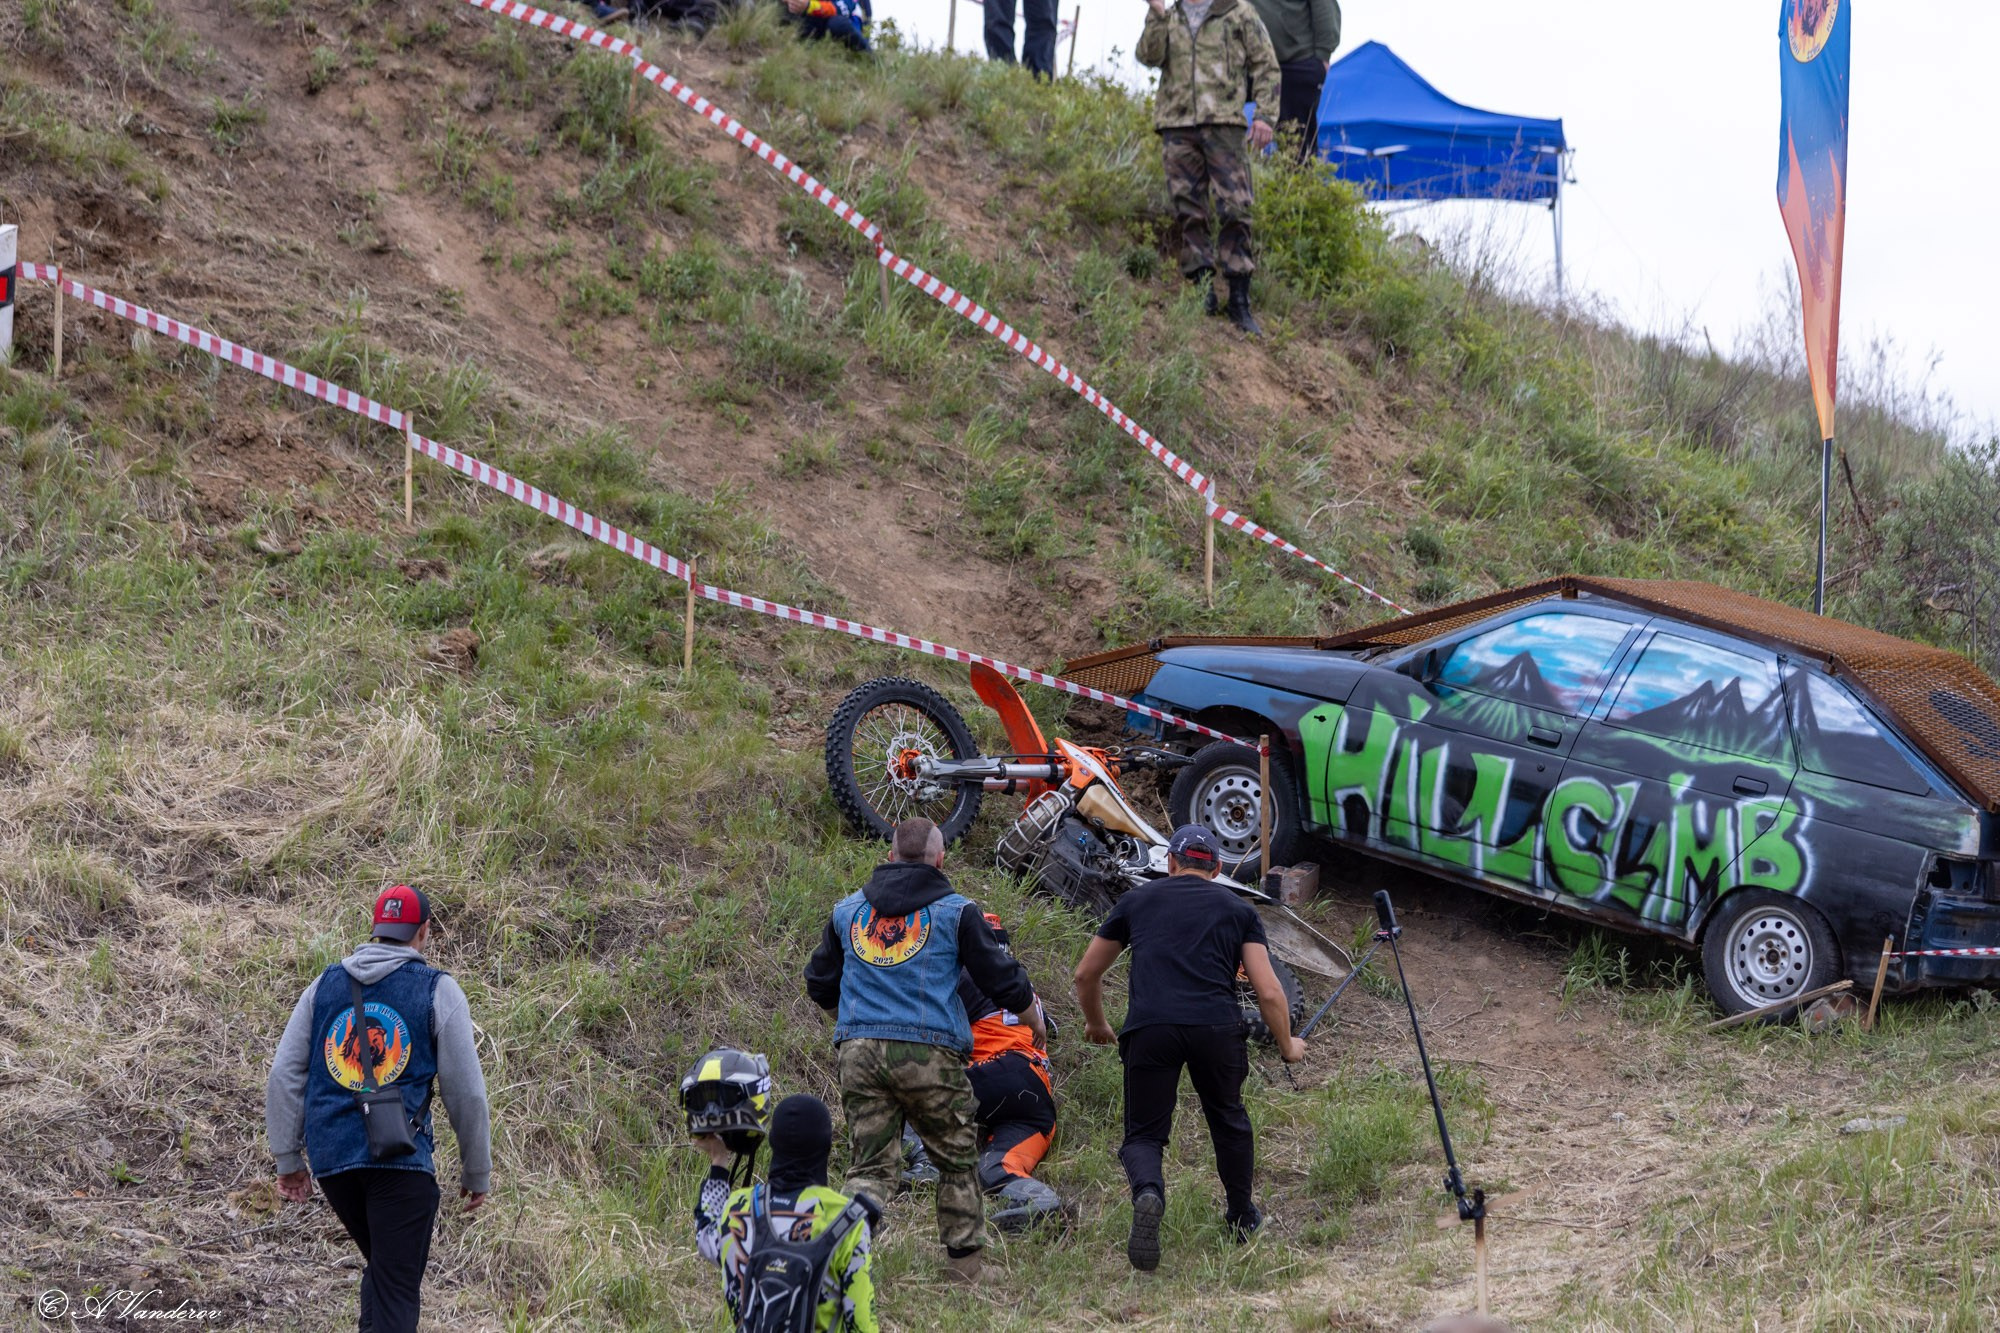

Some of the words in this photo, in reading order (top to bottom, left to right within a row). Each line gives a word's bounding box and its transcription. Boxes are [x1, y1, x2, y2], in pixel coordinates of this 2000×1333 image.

[853, 927, 866, 956] РОССИЯ
[904, 928, 927, 957] ОМСК55
[873, 956, 894, 964] 2022
[328, 1043, 342, 1079] РОССИЯ
[384, 1049, 408, 1082] ОМСК55
